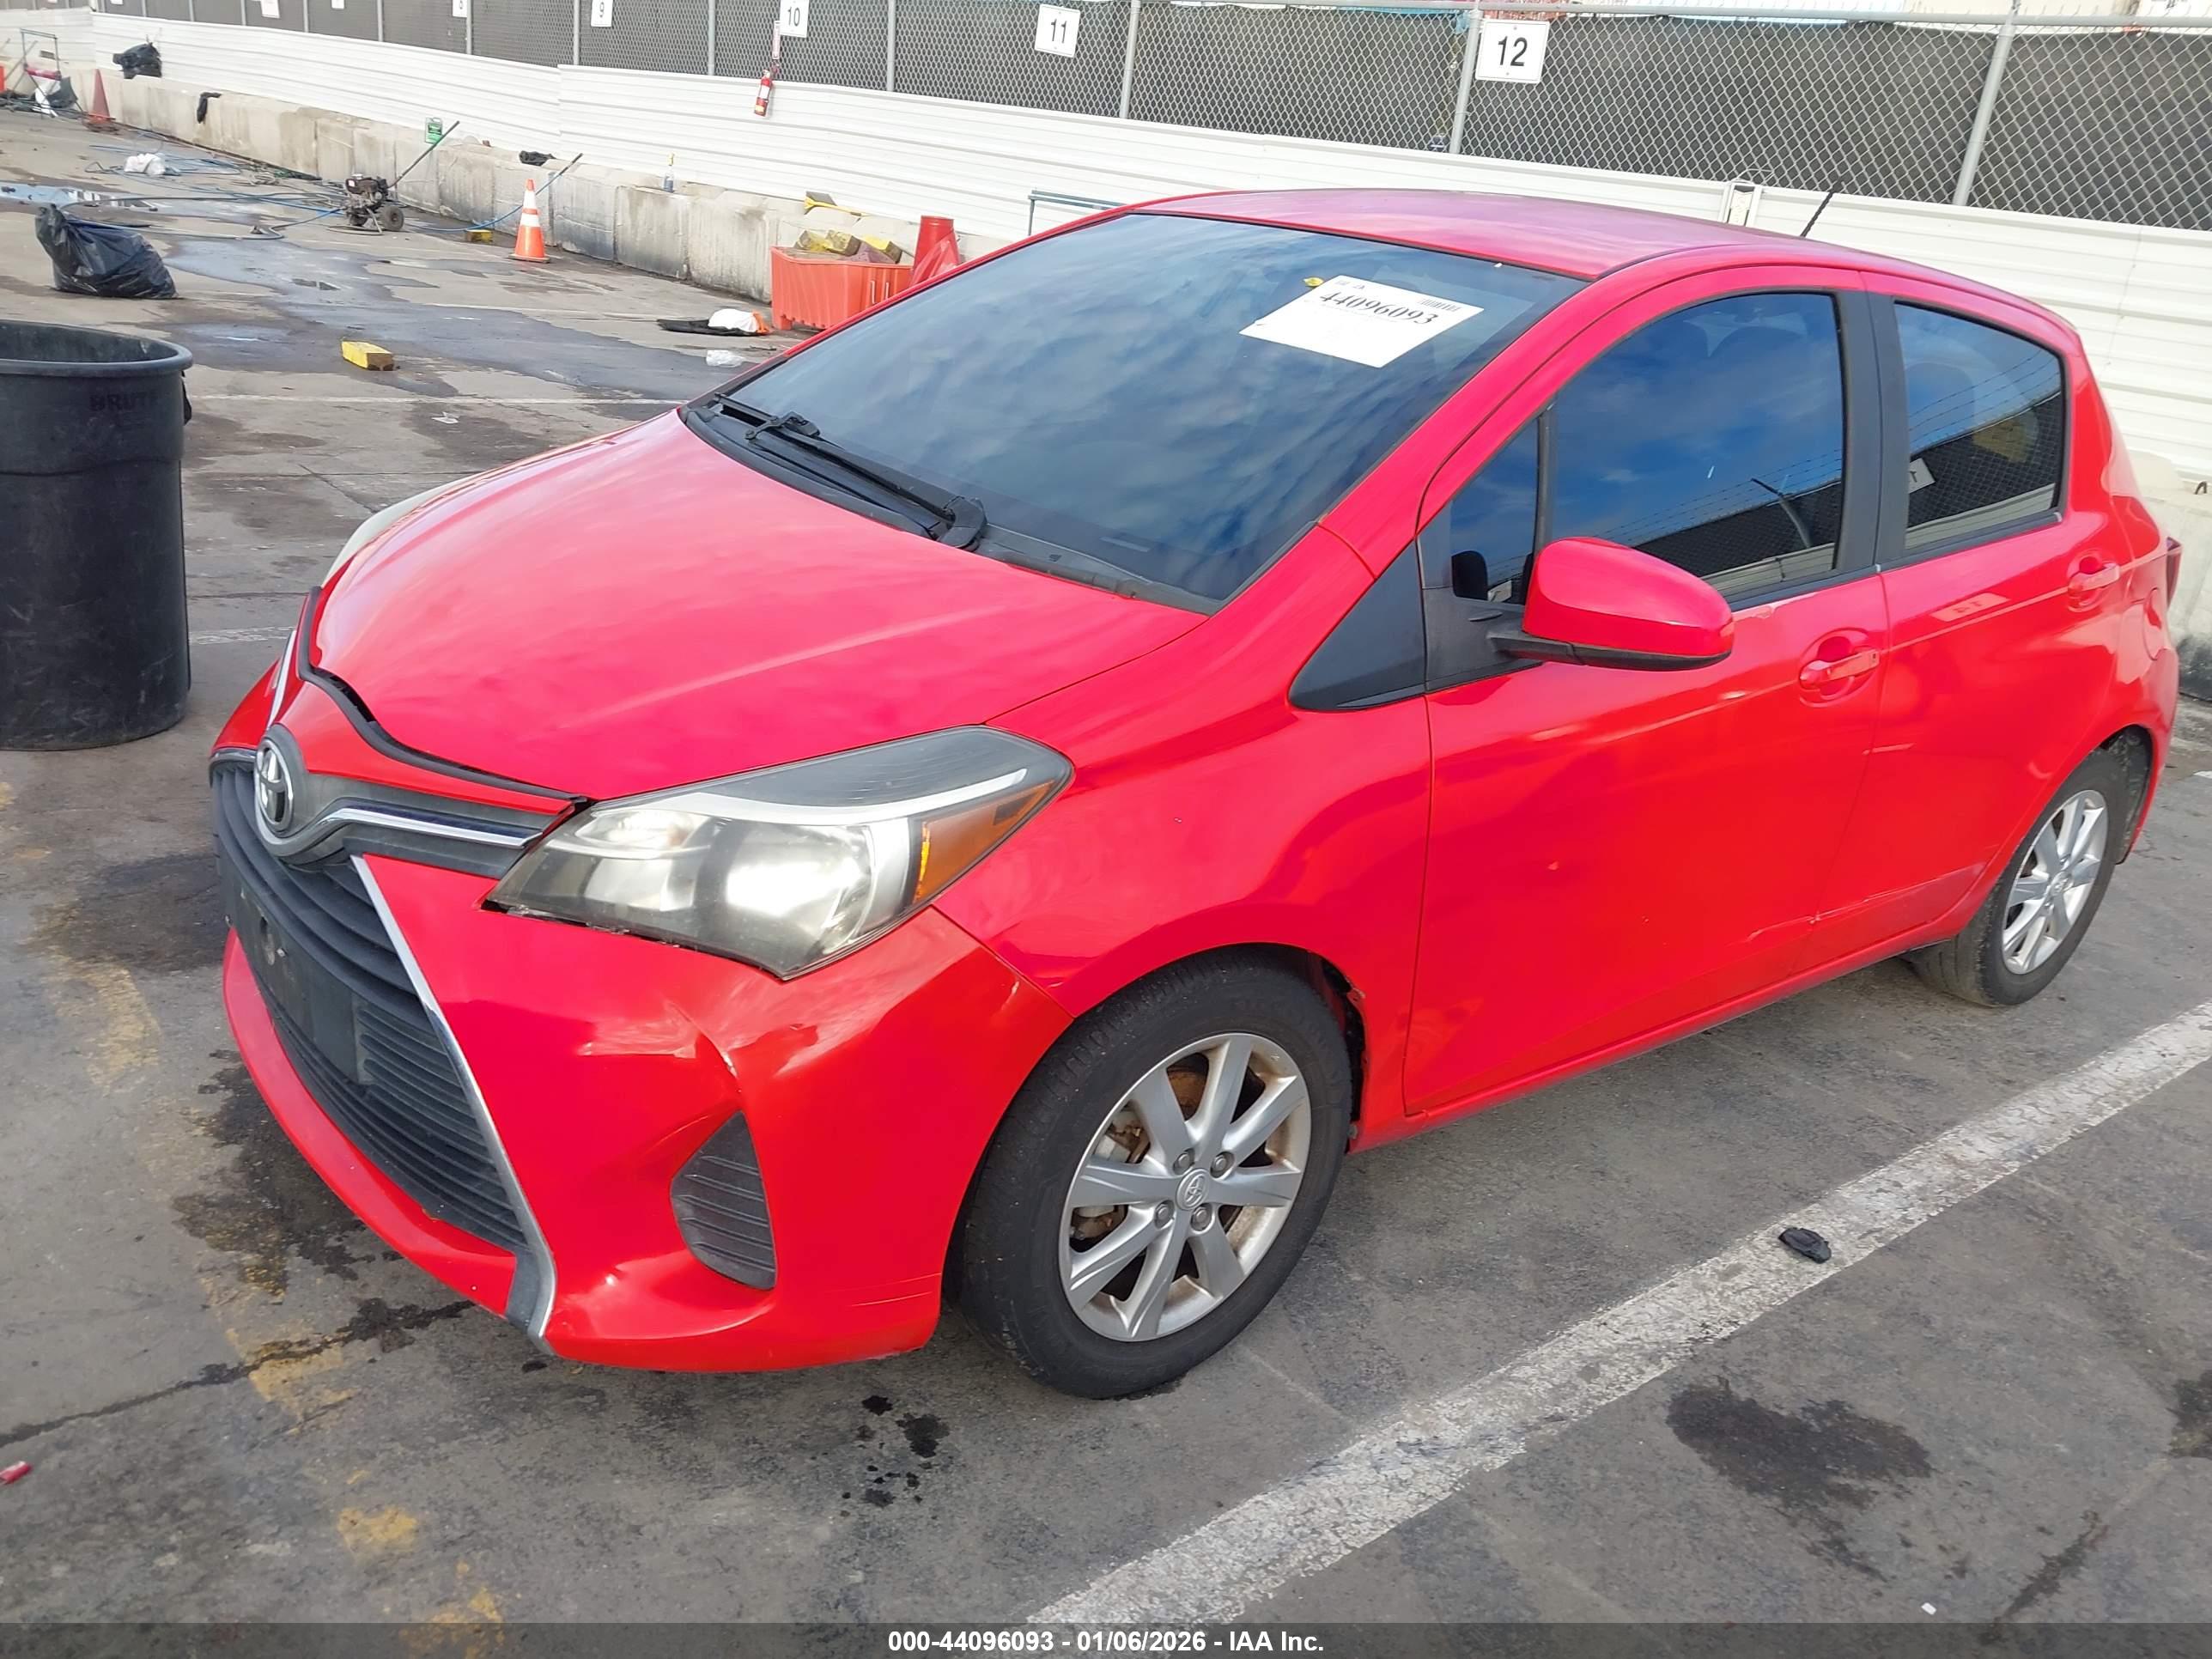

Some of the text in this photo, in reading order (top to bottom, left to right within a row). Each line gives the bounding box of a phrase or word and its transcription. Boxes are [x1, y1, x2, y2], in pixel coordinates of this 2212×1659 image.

[787, 7, 800, 27] 10
[1050, 18, 1067, 44] 11
[1498, 35, 1528, 67] 12
[1320, 291, 1439, 325] 44096093
